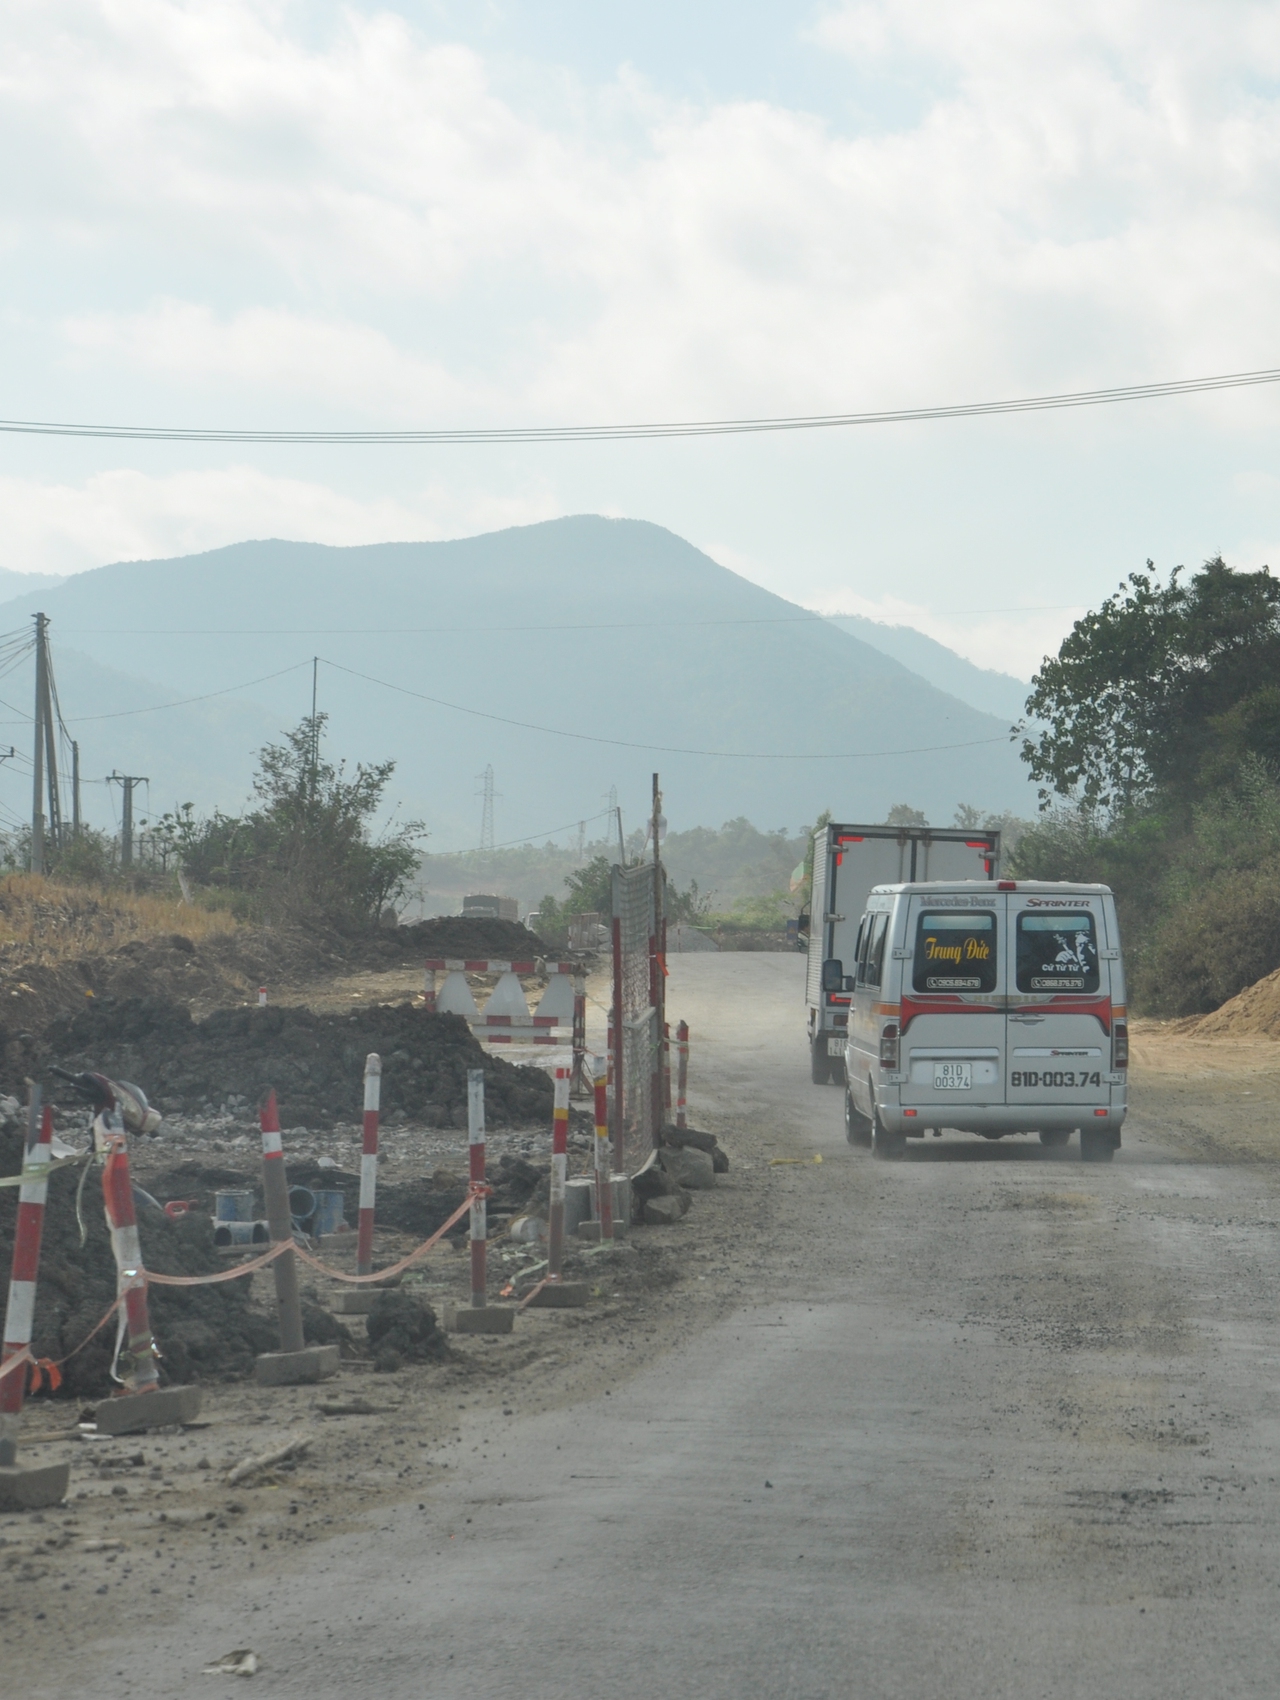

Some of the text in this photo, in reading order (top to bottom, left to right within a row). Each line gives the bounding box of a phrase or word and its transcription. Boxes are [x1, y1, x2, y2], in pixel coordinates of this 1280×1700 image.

[919, 896, 997, 907] Mercedes-Benz
[1026, 898, 1090, 908] SPRINTER
[924, 937, 990, 965] Trung Đức
[1050, 1049, 1089, 1057] SPRINTER
[942, 1064, 963, 1076] 81D
[935, 1076, 970, 1088] 003.74
